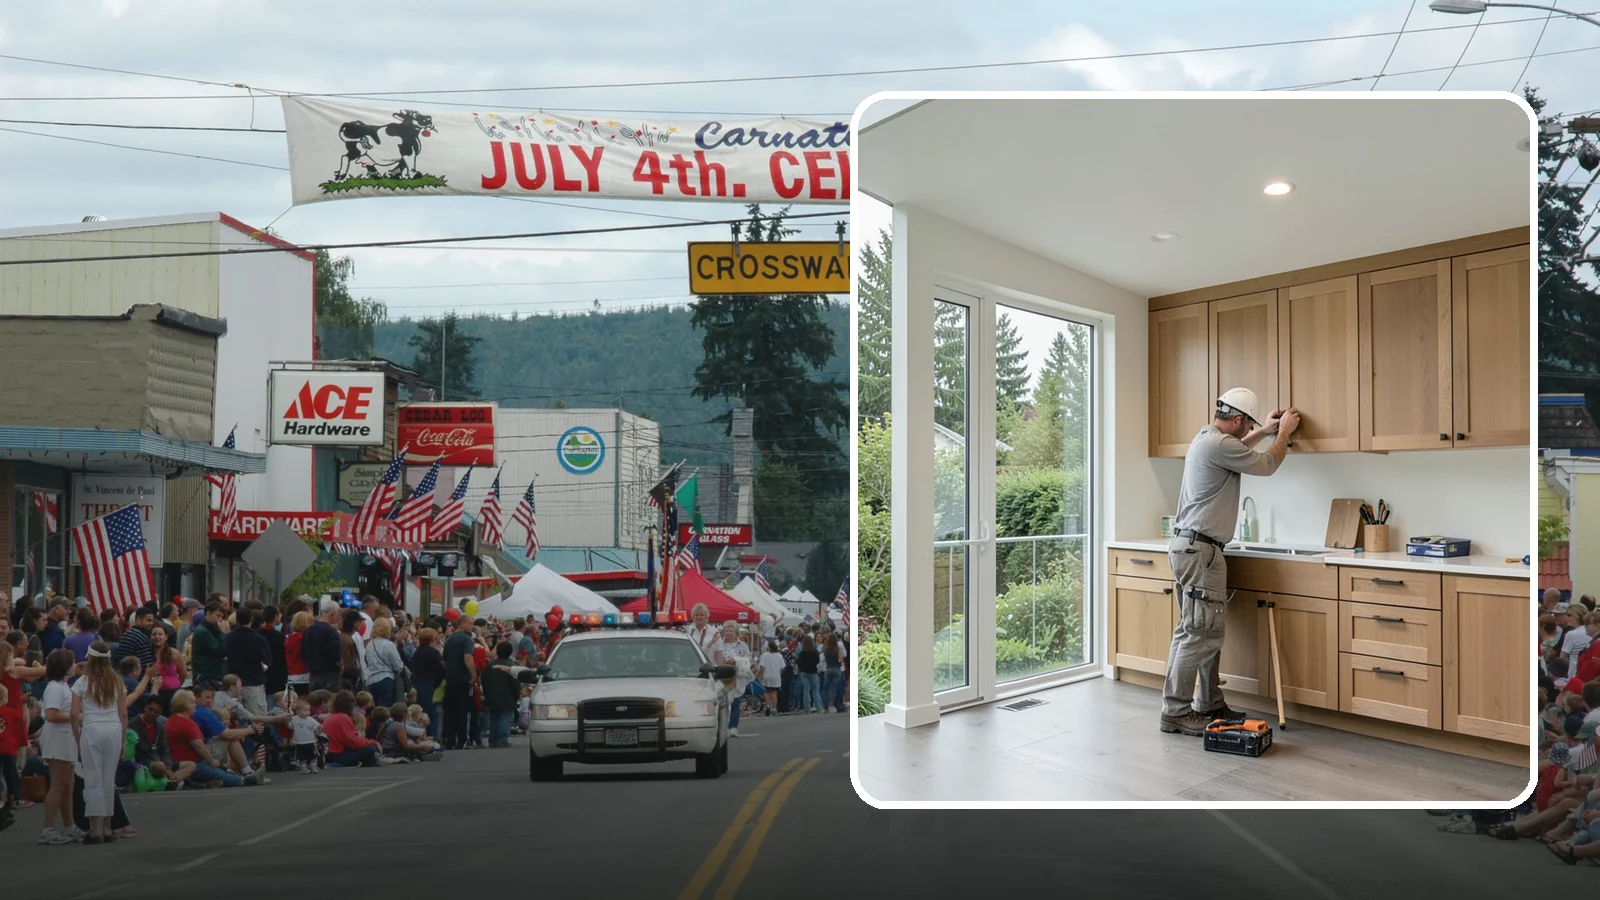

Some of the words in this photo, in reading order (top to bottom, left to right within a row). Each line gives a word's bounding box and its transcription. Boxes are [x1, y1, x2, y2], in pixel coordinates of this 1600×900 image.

[481, 141, 605, 192] JULY
[632, 150, 746, 197] 4th.
[697, 254, 850, 280] CROSSWA
[283, 380, 373, 420] ACE
[406, 410, 452, 421] CEDAR
[283, 421, 370, 436] Hardware
[416, 428, 476, 447] Coca-Cola
[95, 485, 124, 494] Vincent
[126, 484, 136, 494] de
[138, 485, 155, 495] Paul
[688, 527, 741, 535] CRNATION
[699, 535, 730, 543] GLASS
